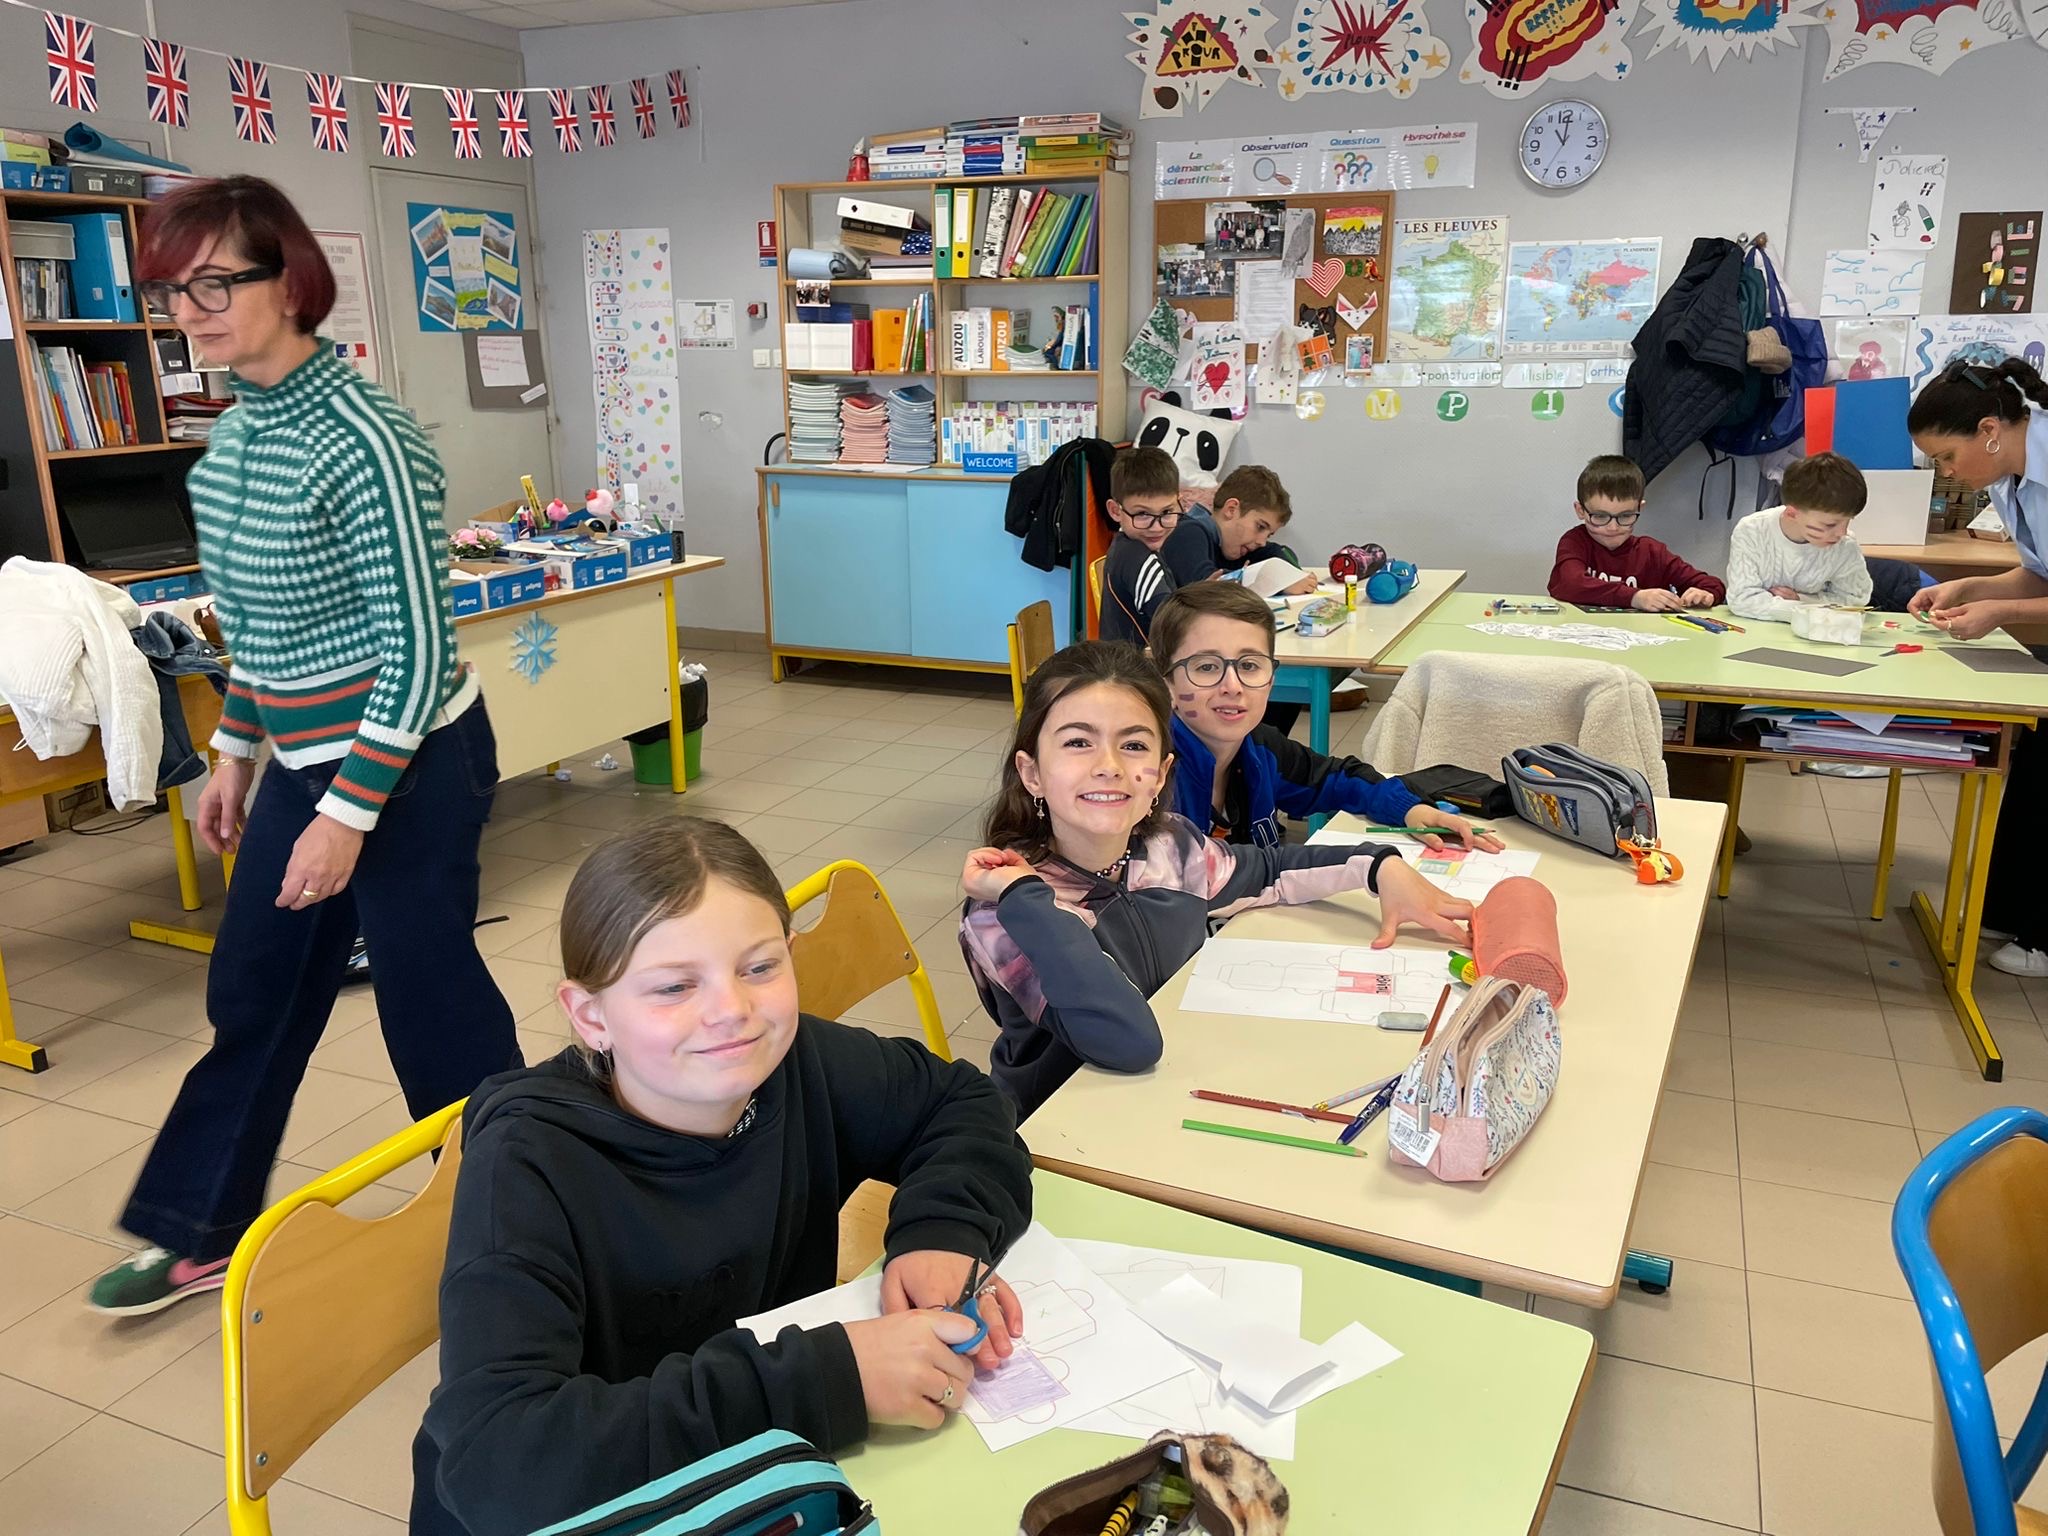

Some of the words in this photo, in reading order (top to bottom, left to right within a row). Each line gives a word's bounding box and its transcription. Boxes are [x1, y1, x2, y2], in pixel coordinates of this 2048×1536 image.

[1558, 110, 1574, 124] 12
[1534, 126, 1543, 135] 10
[1586, 122, 1594, 131] 2
[1241, 141, 1309, 153] Observation
[1329, 137, 1380, 147] Question
[1529, 139, 1540, 152] 9
[1586, 135, 1598, 148] 3
[1533, 157, 1541, 166] 8
[1542, 168, 1548, 179] 7
[1556, 166, 1567, 179] 6
[1574, 166, 1581, 174] 5
[1403, 223, 1428, 234] LES
[1434, 220, 1498, 233] FLEUVES
[954, 322, 964, 362] AUZOU
[977, 320, 985, 364] LAROUSSE
[1445, 393, 1467, 417] P
[966, 457, 1014, 468] WELCOME
[606, 567, 623, 576] Budget
[525, 582, 541, 592] Budget
[458, 598, 477, 608] Budget
